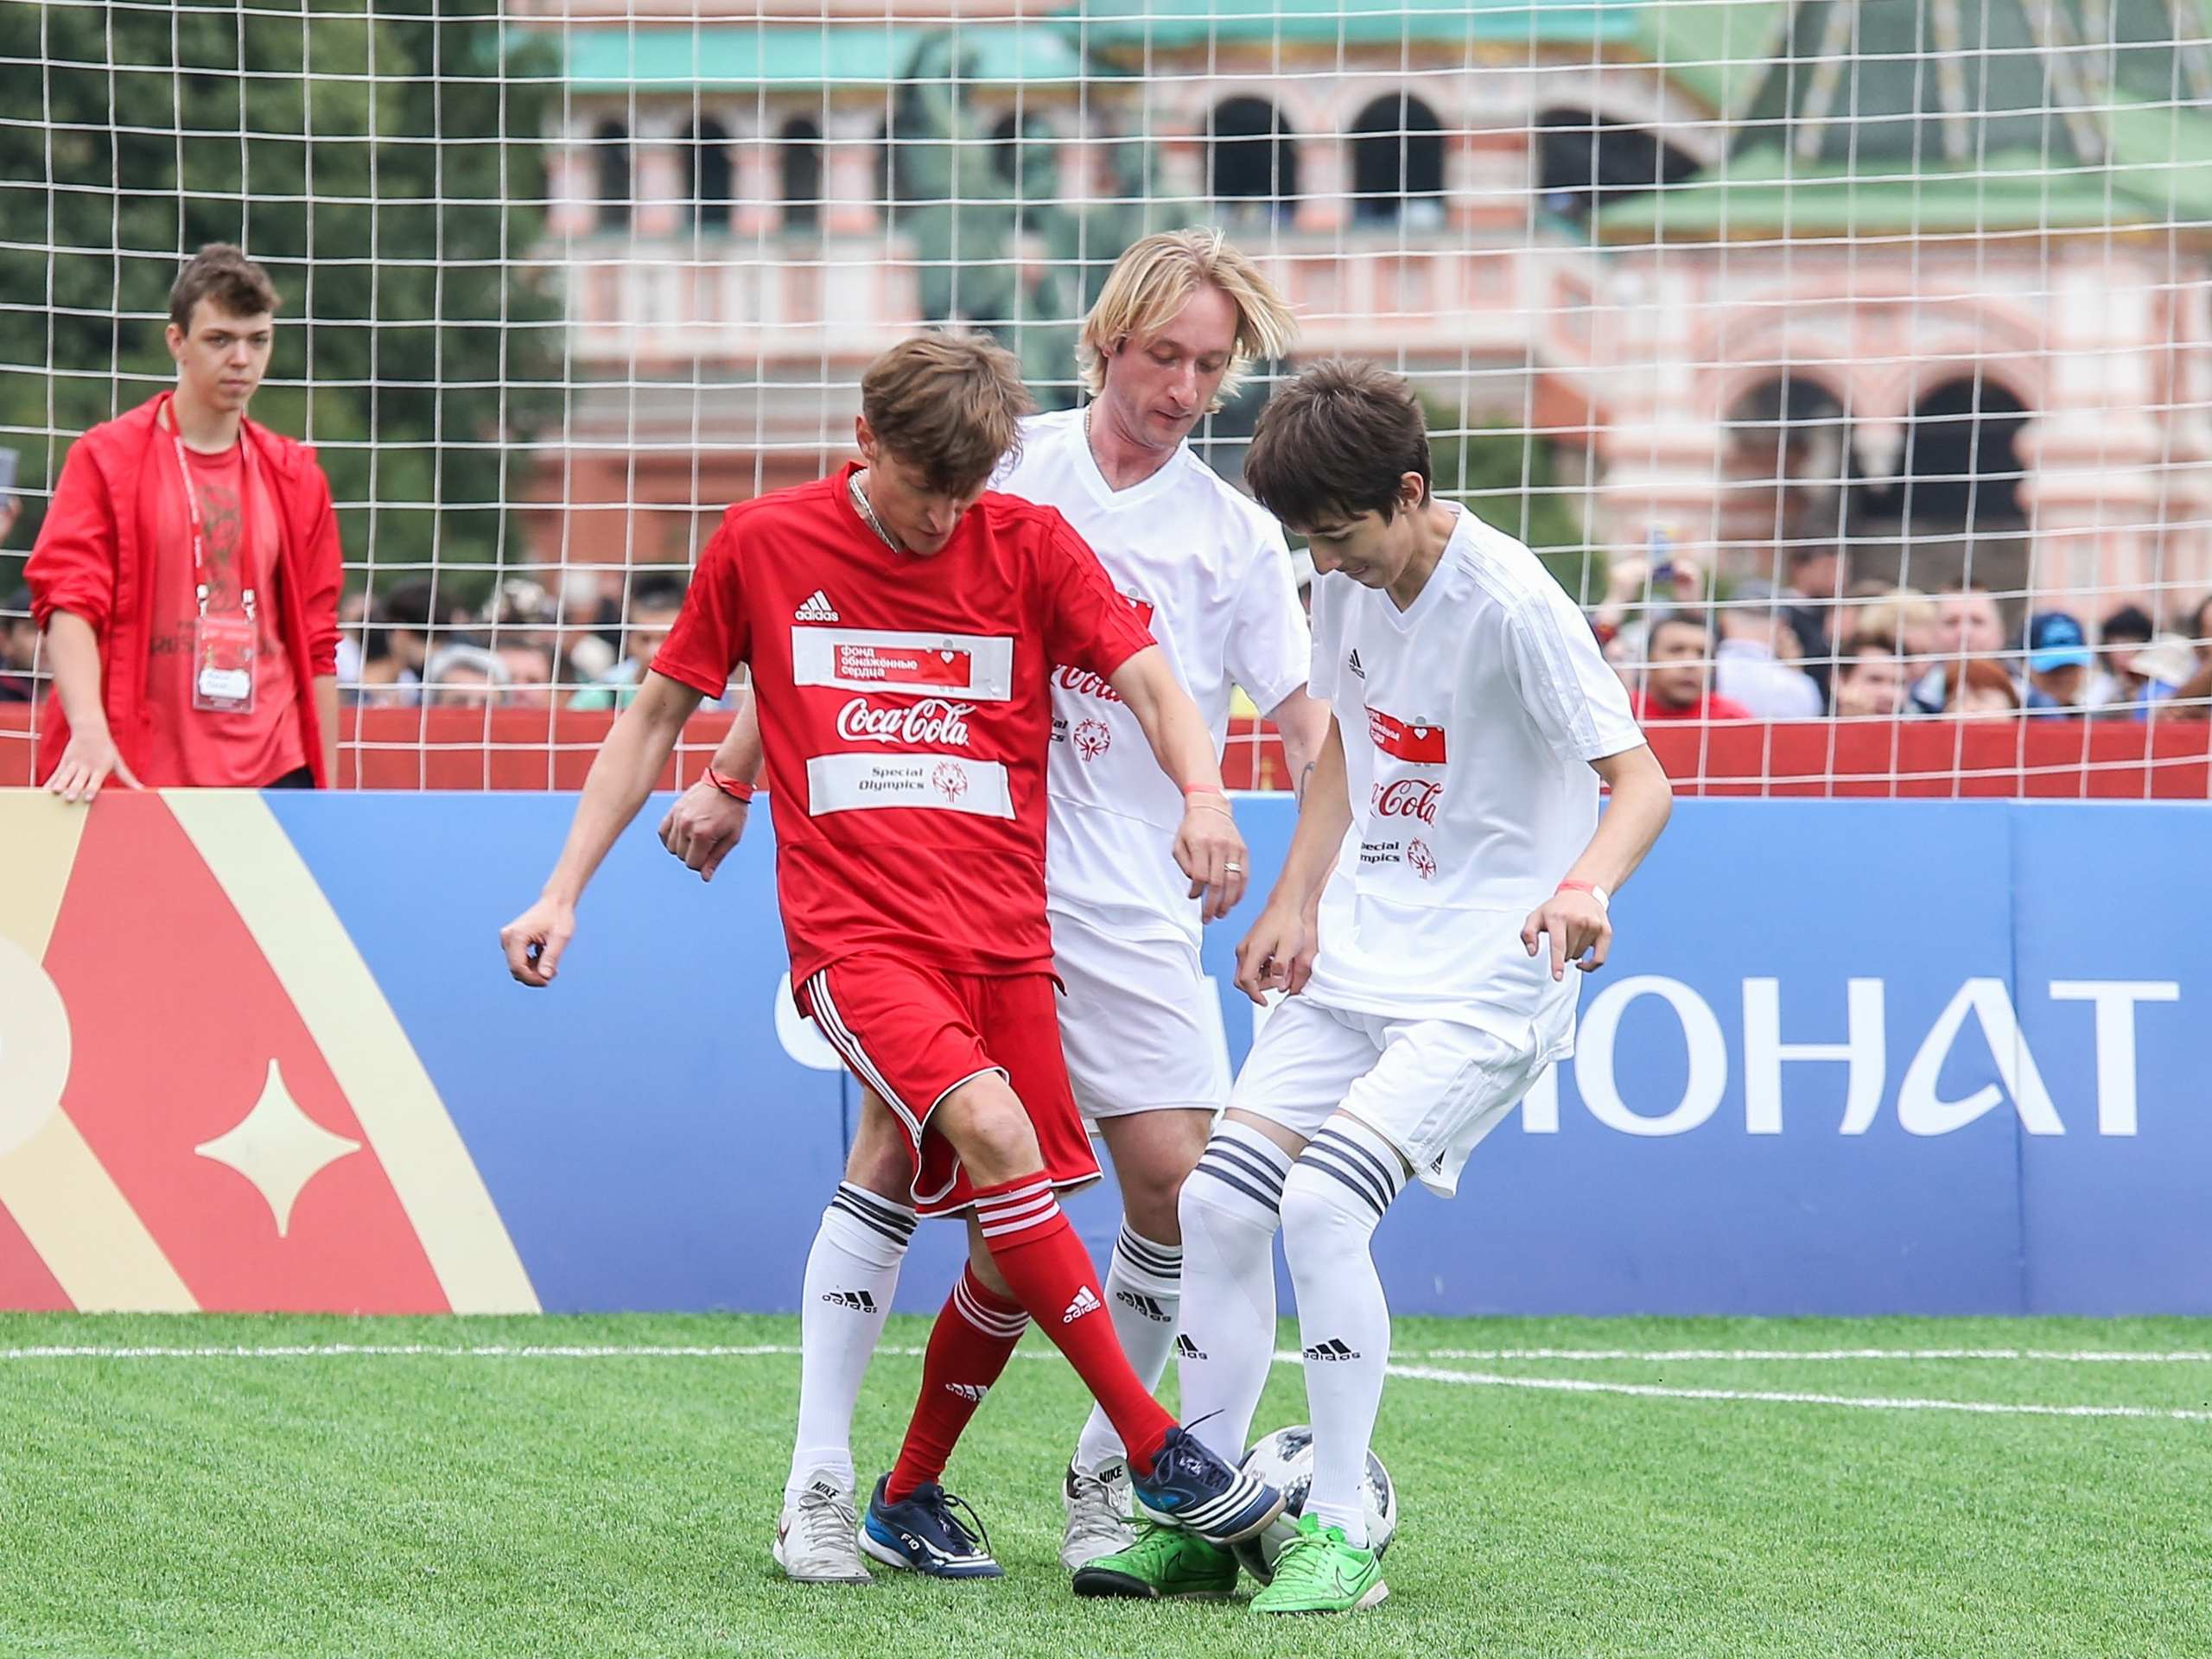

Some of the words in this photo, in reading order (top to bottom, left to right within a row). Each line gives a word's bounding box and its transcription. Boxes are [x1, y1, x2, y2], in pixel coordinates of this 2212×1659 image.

[794, 608, 839, 621] adidas
[841, 645, 874, 658] фонд
[841, 657, 918, 670] обнажённые
[841, 666, 886, 678] сердца
[836, 697, 976, 746] Coca-Cola
[872, 766, 924, 779] Special
[859, 779, 925, 791] Olympics
[822, 1294, 878, 1314] adidas
[1116, 1291, 1172, 1323] adidas
[1063, 1300, 1102, 1324] adidas
[1099, 1465, 1123, 1482] NIKE
[811, 1481, 840, 1500] NIKE
